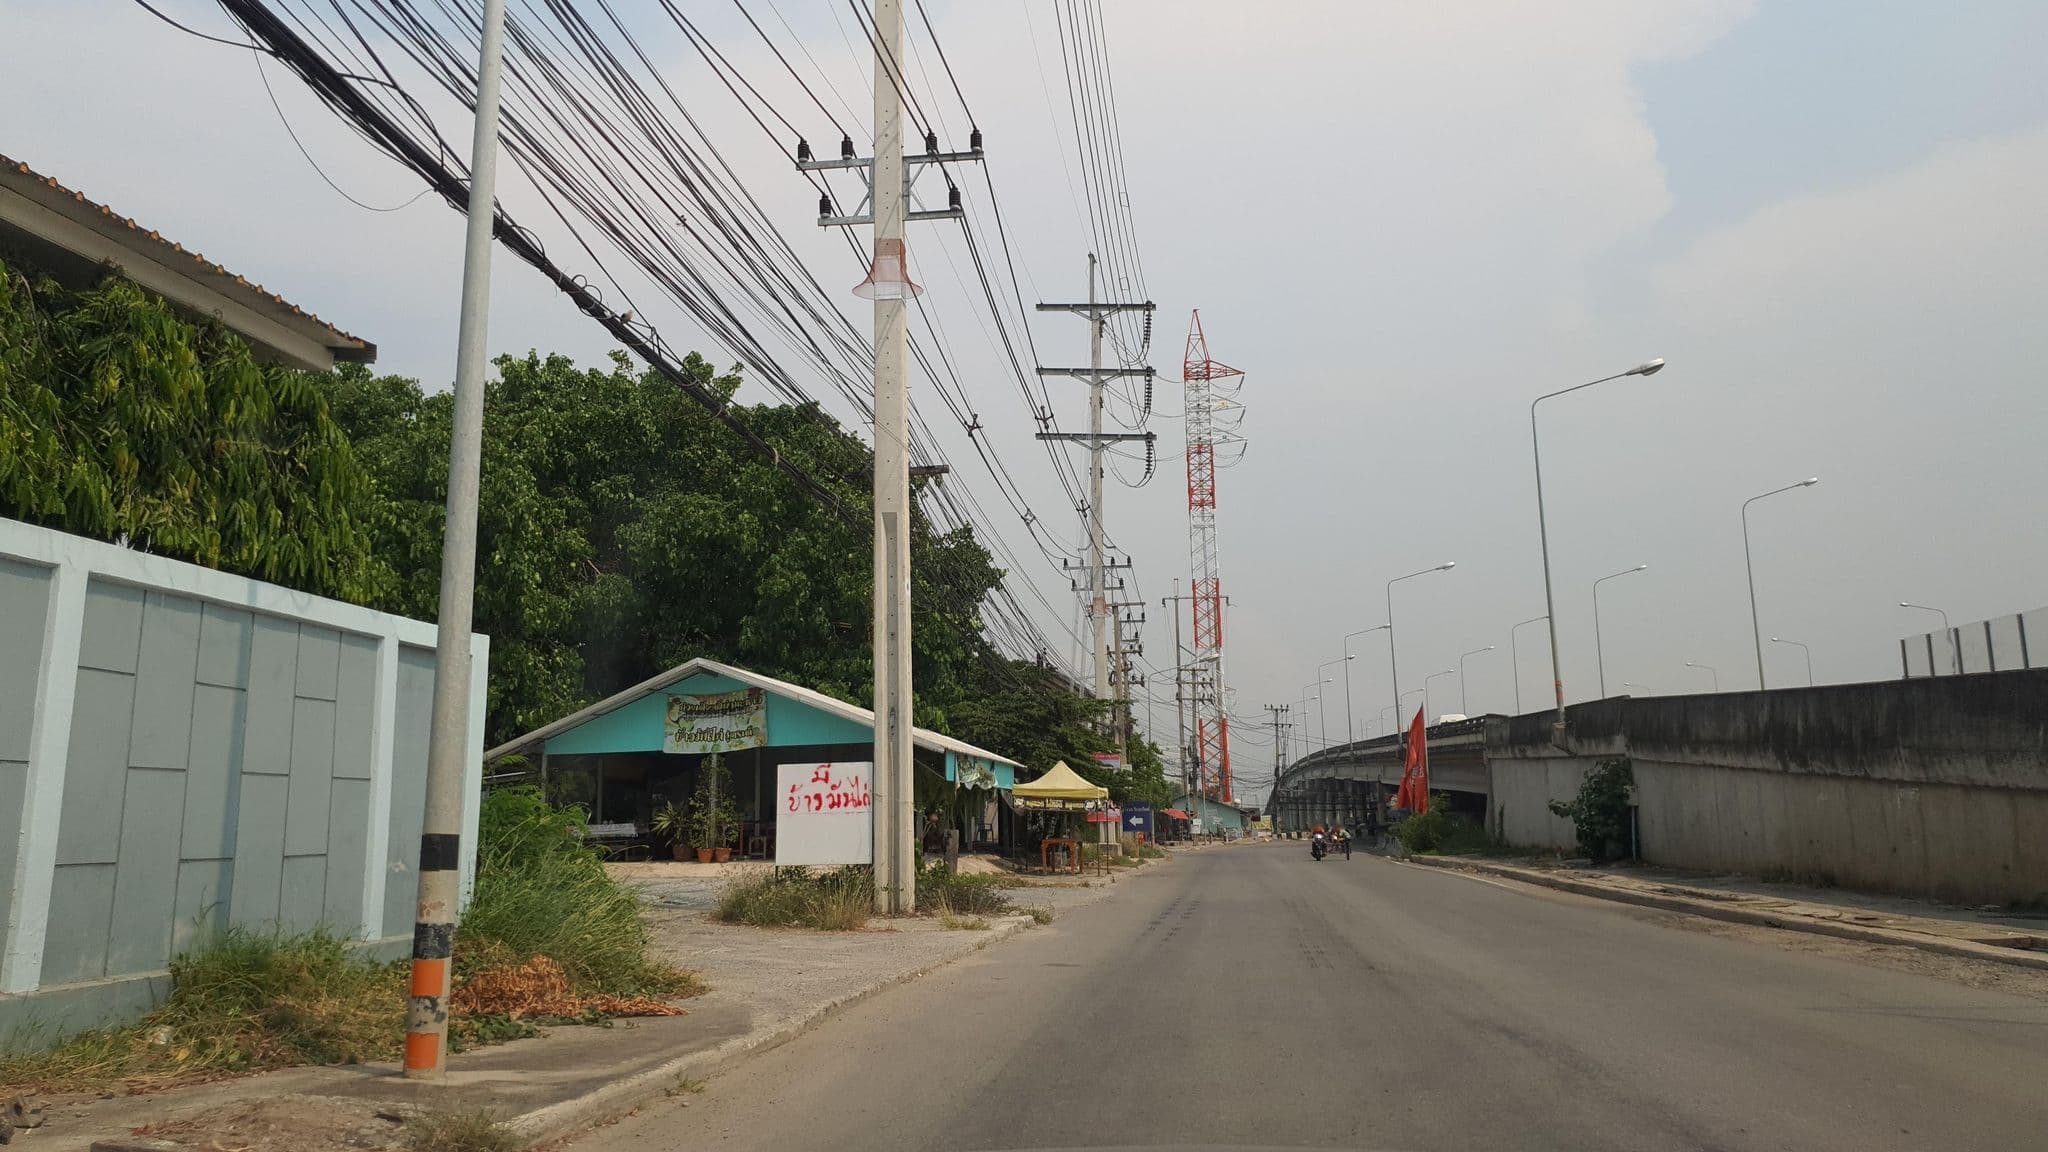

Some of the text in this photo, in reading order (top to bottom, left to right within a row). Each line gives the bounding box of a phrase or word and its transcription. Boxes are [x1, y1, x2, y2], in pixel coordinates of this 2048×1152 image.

[811, 763, 831, 784] มี
[788, 775, 871, 813] ข้าวมันไก่
